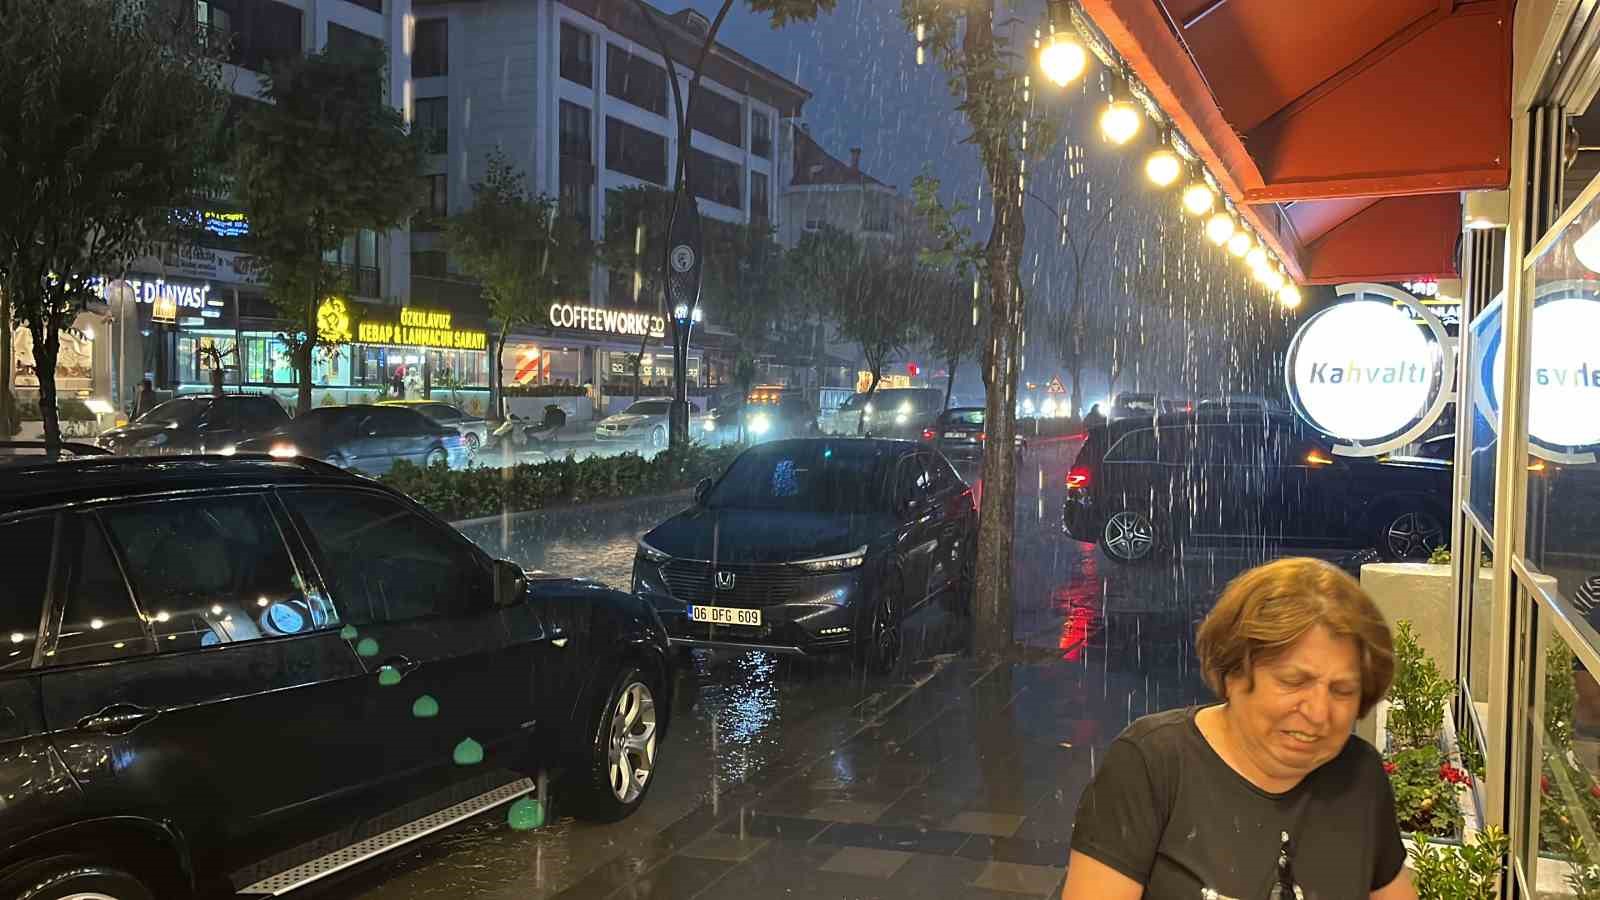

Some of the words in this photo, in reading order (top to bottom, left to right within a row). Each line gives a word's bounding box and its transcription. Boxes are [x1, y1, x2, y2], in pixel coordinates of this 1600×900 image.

[400, 307, 451, 329] ÖZKILAVUZ
[359, 323, 393, 343] KEBAP
[394, 325, 401, 344] &
[403, 327, 454, 347] LAHMACUN
[454, 331, 486, 349] SARAYI
[694, 607, 707, 620] 06
[712, 608, 732, 621] DFG
[738, 610, 758, 624] 609
